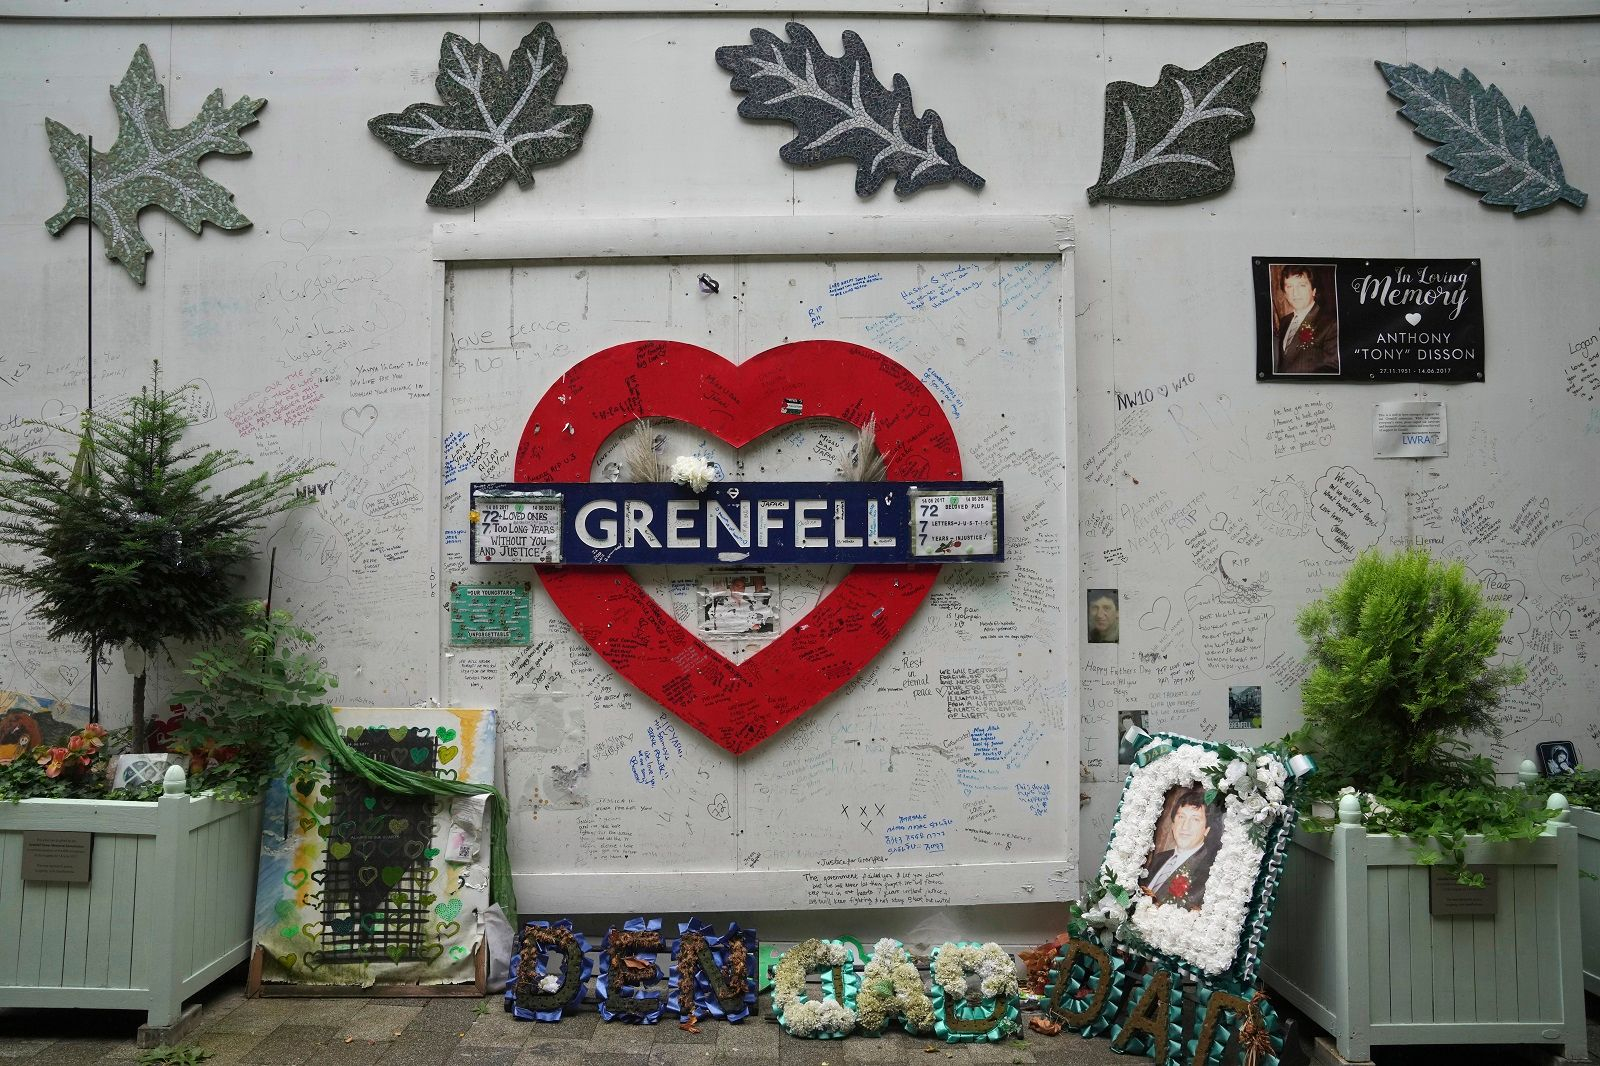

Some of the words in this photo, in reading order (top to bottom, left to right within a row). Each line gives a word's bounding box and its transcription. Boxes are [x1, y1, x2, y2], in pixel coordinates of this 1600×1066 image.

[1395, 266, 1412, 284] In
[1417, 266, 1469, 290] Loving
[1352, 274, 1468, 320] Memory
[1376, 332, 1451, 344] ANTHONY
[1417, 348, 1475, 360] DISSON
[1171, 372, 1196, 392] W10
[1117, 388, 1154, 411] NW10
[1402, 435, 1431, 445] LWRA
[527, 512, 548, 521] ONES
[920, 504, 939, 517] 72
[508, 523, 528, 534] LONG
[530, 523, 555, 534] YEARS
[574, 499, 897, 549] GRENFELL
[919, 520, 928, 533] 7
[490, 535, 527, 546] WITHOUT
[919, 533, 928, 546] 7
[480, 546, 496, 556] AND
[901, 656, 922, 669] Rest
[902, 674, 930, 688] eternal
[912, 687, 932, 701] peace
[803, 872, 818, 881] The
[823, 873, 859, 884] government
